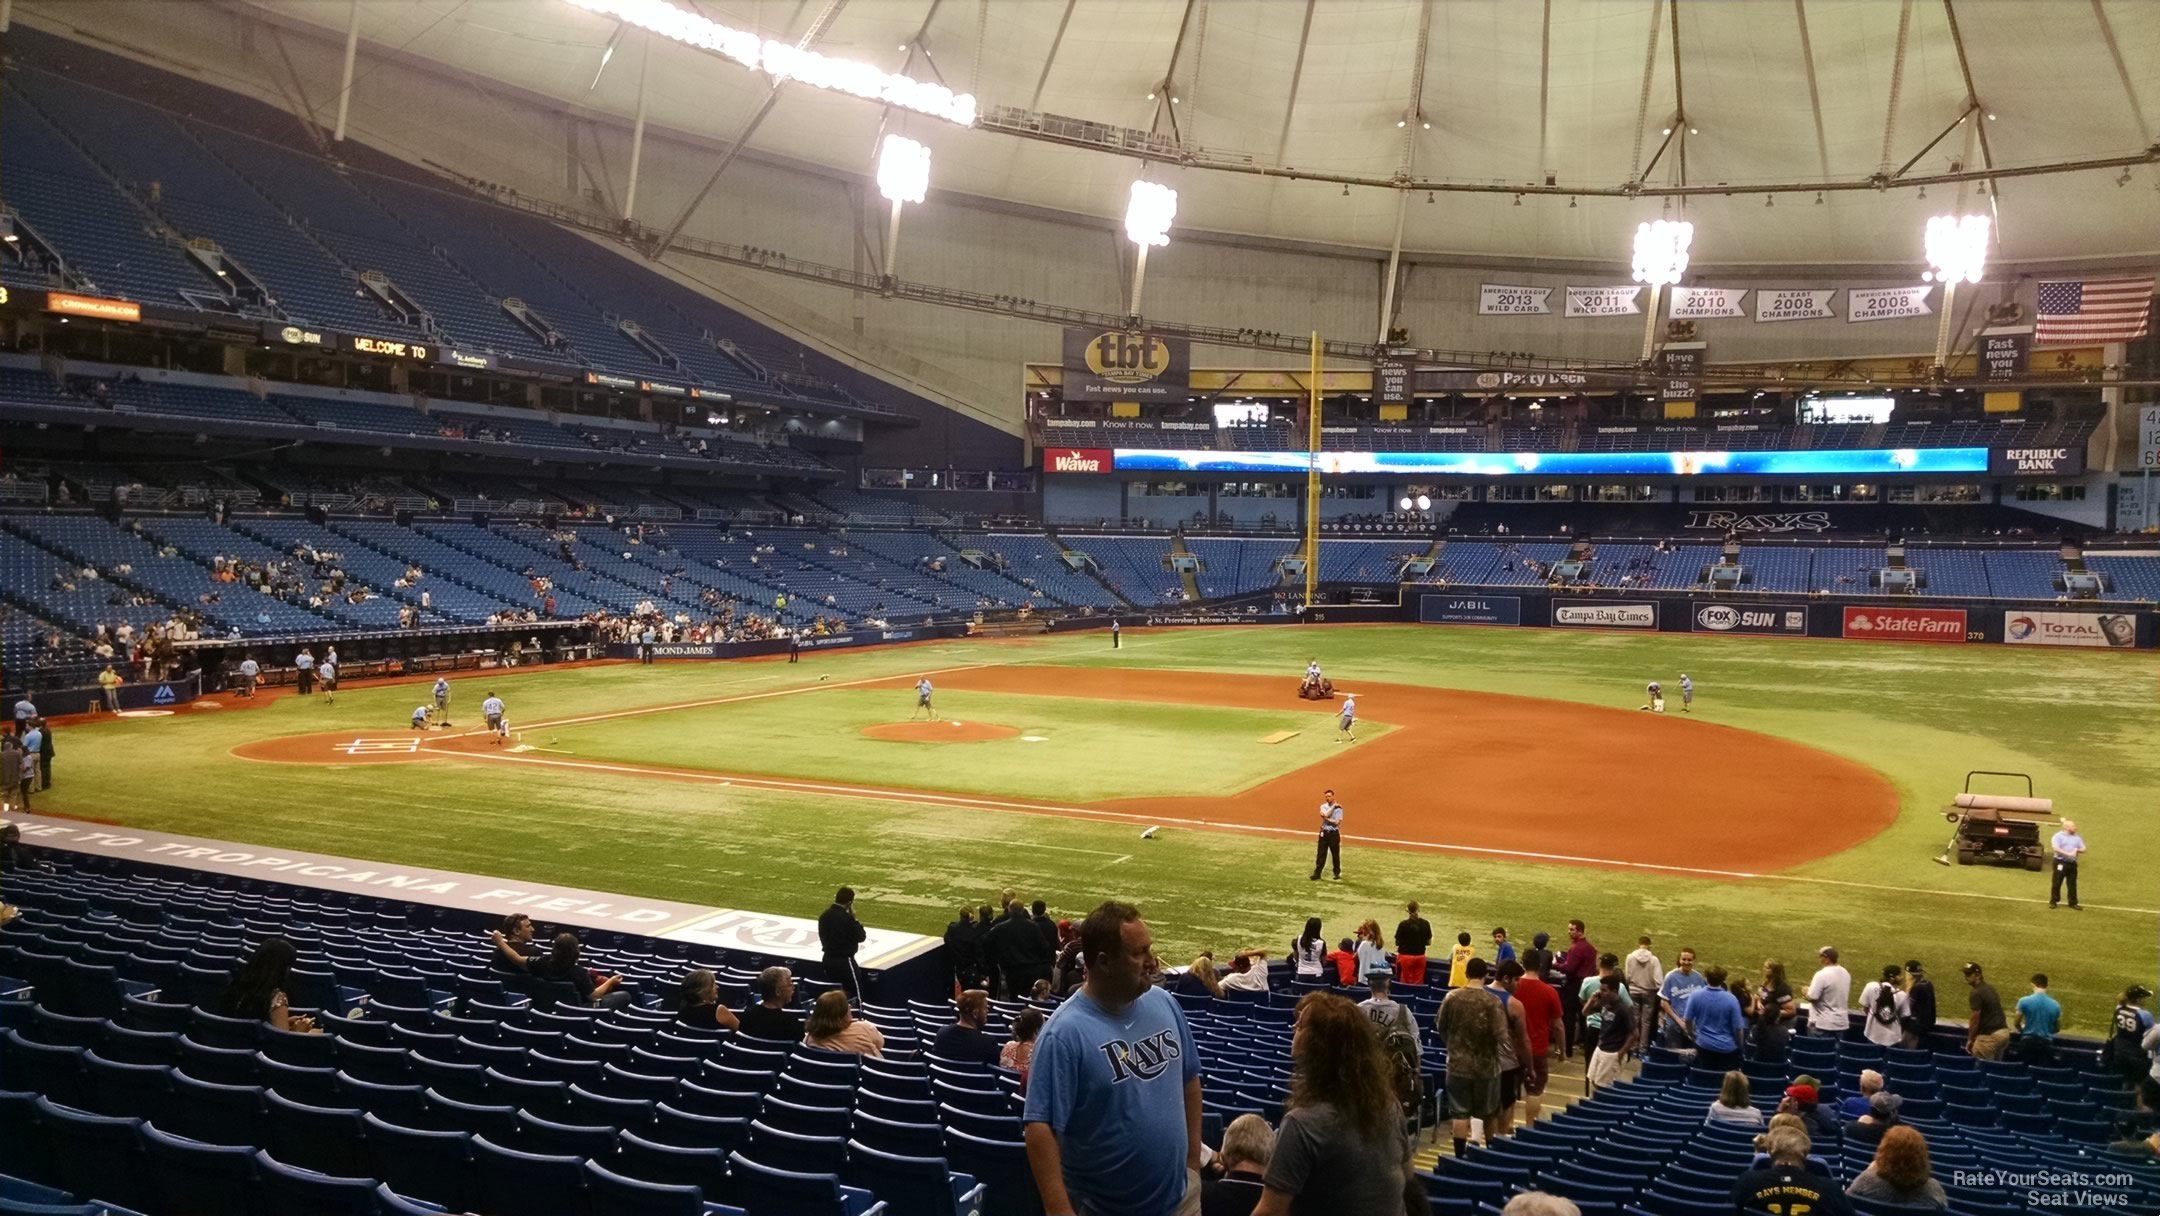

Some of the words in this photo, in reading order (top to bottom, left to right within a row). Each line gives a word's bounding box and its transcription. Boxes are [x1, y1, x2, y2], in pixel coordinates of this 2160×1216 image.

[1607, 288, 1636, 296] LEAGUE
[1855, 291, 1892, 299] AMERICAN
[1498, 295, 1533, 306] 2013
[1584, 296, 1619, 307] 2011
[1687, 296, 1725, 308] 2010
[1774, 298, 1814, 310] 2008
[1868, 295, 1910, 310] 2008
[1514, 305, 1540, 313] CARD
[1573, 306, 1597, 314] WILD
[1601, 306, 1628, 314] CARD
[1675, 308, 1735, 316] CHAMPIONS
[1761, 309, 1824, 319] CHAMPIONS
[1854, 306, 1921, 319] CHAMPIONS
[304, 331, 321, 344] SUN
[354, 337, 406, 357] WELCOME
[411, 345, 426, 359] TO
[1988, 339, 2014, 350] Fast
[1096, 335, 1159, 370] tbt
[1666, 353, 1694, 363] Have
[1986, 349, 2019, 360] news
[1991, 360, 2013, 369] you
[1381, 368, 1408, 376] news
[1385, 376, 1403, 386] you
[1503, 372, 1546, 387] Party
[1670, 380, 1689, 390] the
[1085, 385, 1102, 393] Fast
[1123, 387, 1137, 395] you
[1663, 388, 1696, 398] buzz?
[2146, 410, 2160, 425] 4
[1047, 418, 1096, 429] tampabay.com
[1103, 421, 1127, 429] Know
[1128, 421, 1134, 429] it
[1136, 422, 1156, 430] now.
[1161, 421, 1210, 431] tampabay.com
[1655, 425, 1675, 433] Know
[2006, 449, 2067, 460] REPUBLIC
[1055, 456, 1099, 472] Wawa
[2018, 459, 2055, 470] BANK
[1684, 510, 1831, 532] RAYS
[1288, 592, 1327, 600] LANING
[1449, 601, 1491, 610] JABIL
[1561, 609, 1595, 623] Tampa
[1596, 609, 1616, 623] Bay
[1617, 609, 1649, 622] Times
[1707, 610, 1732, 621] FOX
[1741, 611, 1776, 627] SUN
[2041, 622, 2098, 634] TOTAL
[1967, 632, 1984, 640] 370
[684, 646, 713, 655] JAMES
[487, 702, 498, 710] 42
[72, 831, 145, 847] TO
[146, 842, 461, 896] TROPICANA
[471, 889, 673, 925] FIELD
[2116, 1014, 2137, 1032] 39
[1098, 1028, 1180, 1085] RAYS
[1756, 1186, 1780, 1199] RAYS
[1782, 1186, 1820, 1201] MEMBER
